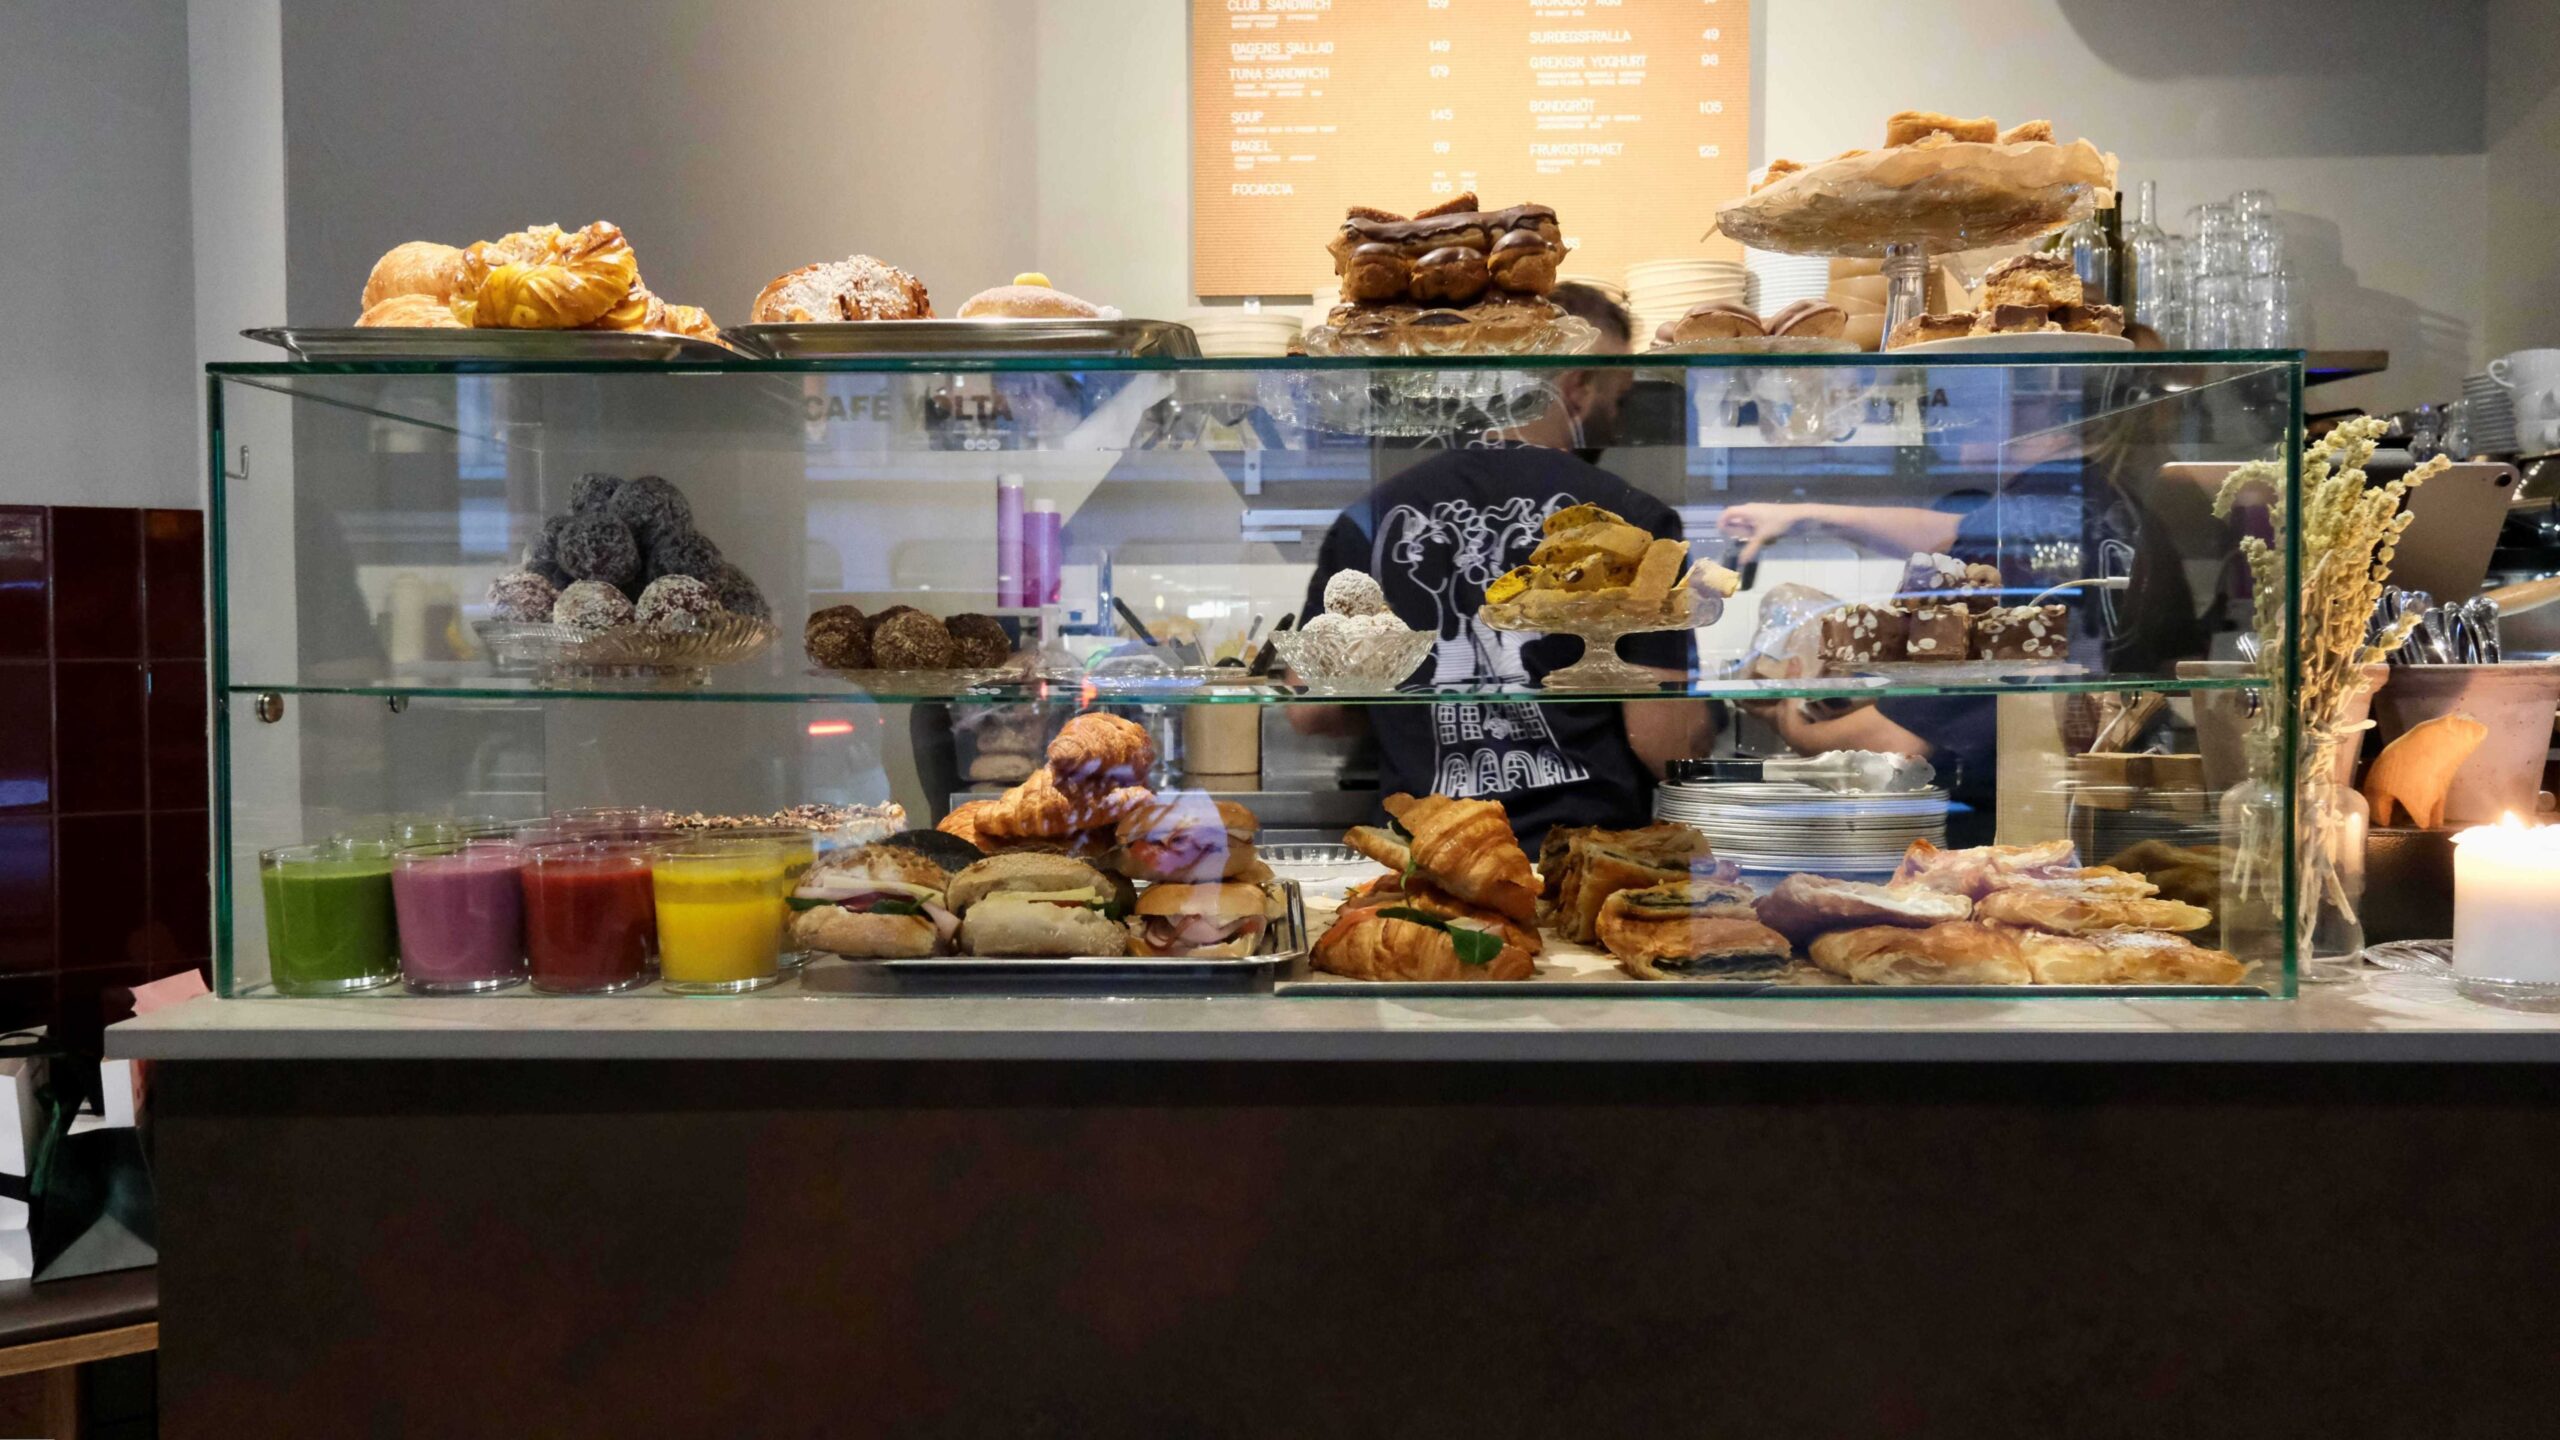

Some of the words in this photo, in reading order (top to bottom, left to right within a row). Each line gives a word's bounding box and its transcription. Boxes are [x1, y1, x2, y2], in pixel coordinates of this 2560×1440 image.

[1227, 0, 1260, 11] CLUB
[1266, 0, 1331, 11] SANDWICH
[1703, 28, 1720, 41] 49
[1231, 43, 1280, 54] DAGENS
[1286, 41, 1334, 54] SALLAD
[1429, 40, 1450, 52] 149
[1529, 56, 1585, 68] GREKISK
[1591, 55, 1647, 67] YOGHURT
[1229, 68, 1262, 80] TUNA
[1265, 67, 1330, 79] SANDWICH
[1699, 101, 1723, 114] 105
[1231, 111, 1264, 123] SOUP
[1431, 109, 1454, 121] 145
[1231, 140, 1272, 152] BAGEL
[1231, 183, 1294, 195] FOCACCIA
[802, 388, 890, 422] CAFÉ
